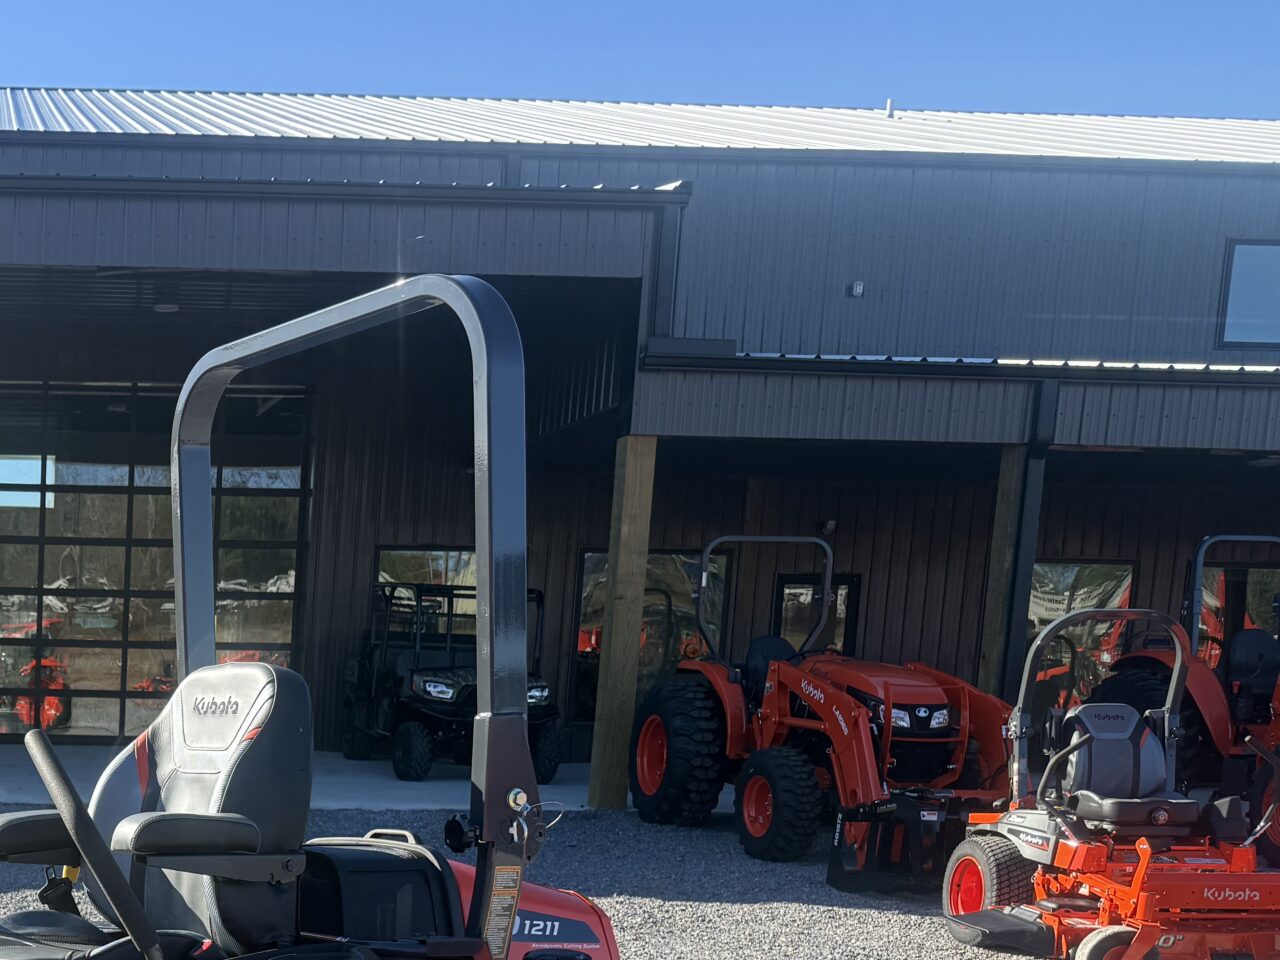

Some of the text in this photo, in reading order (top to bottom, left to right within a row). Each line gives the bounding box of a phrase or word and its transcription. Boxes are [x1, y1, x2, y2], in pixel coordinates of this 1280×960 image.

[801, 678, 825, 704] Kubota
[193, 695, 239, 716] Kubota
[1094, 713, 1125, 721] Kubota
[1203, 887, 1260, 901] Kubota
[1157, 934, 1184, 948] 0"
